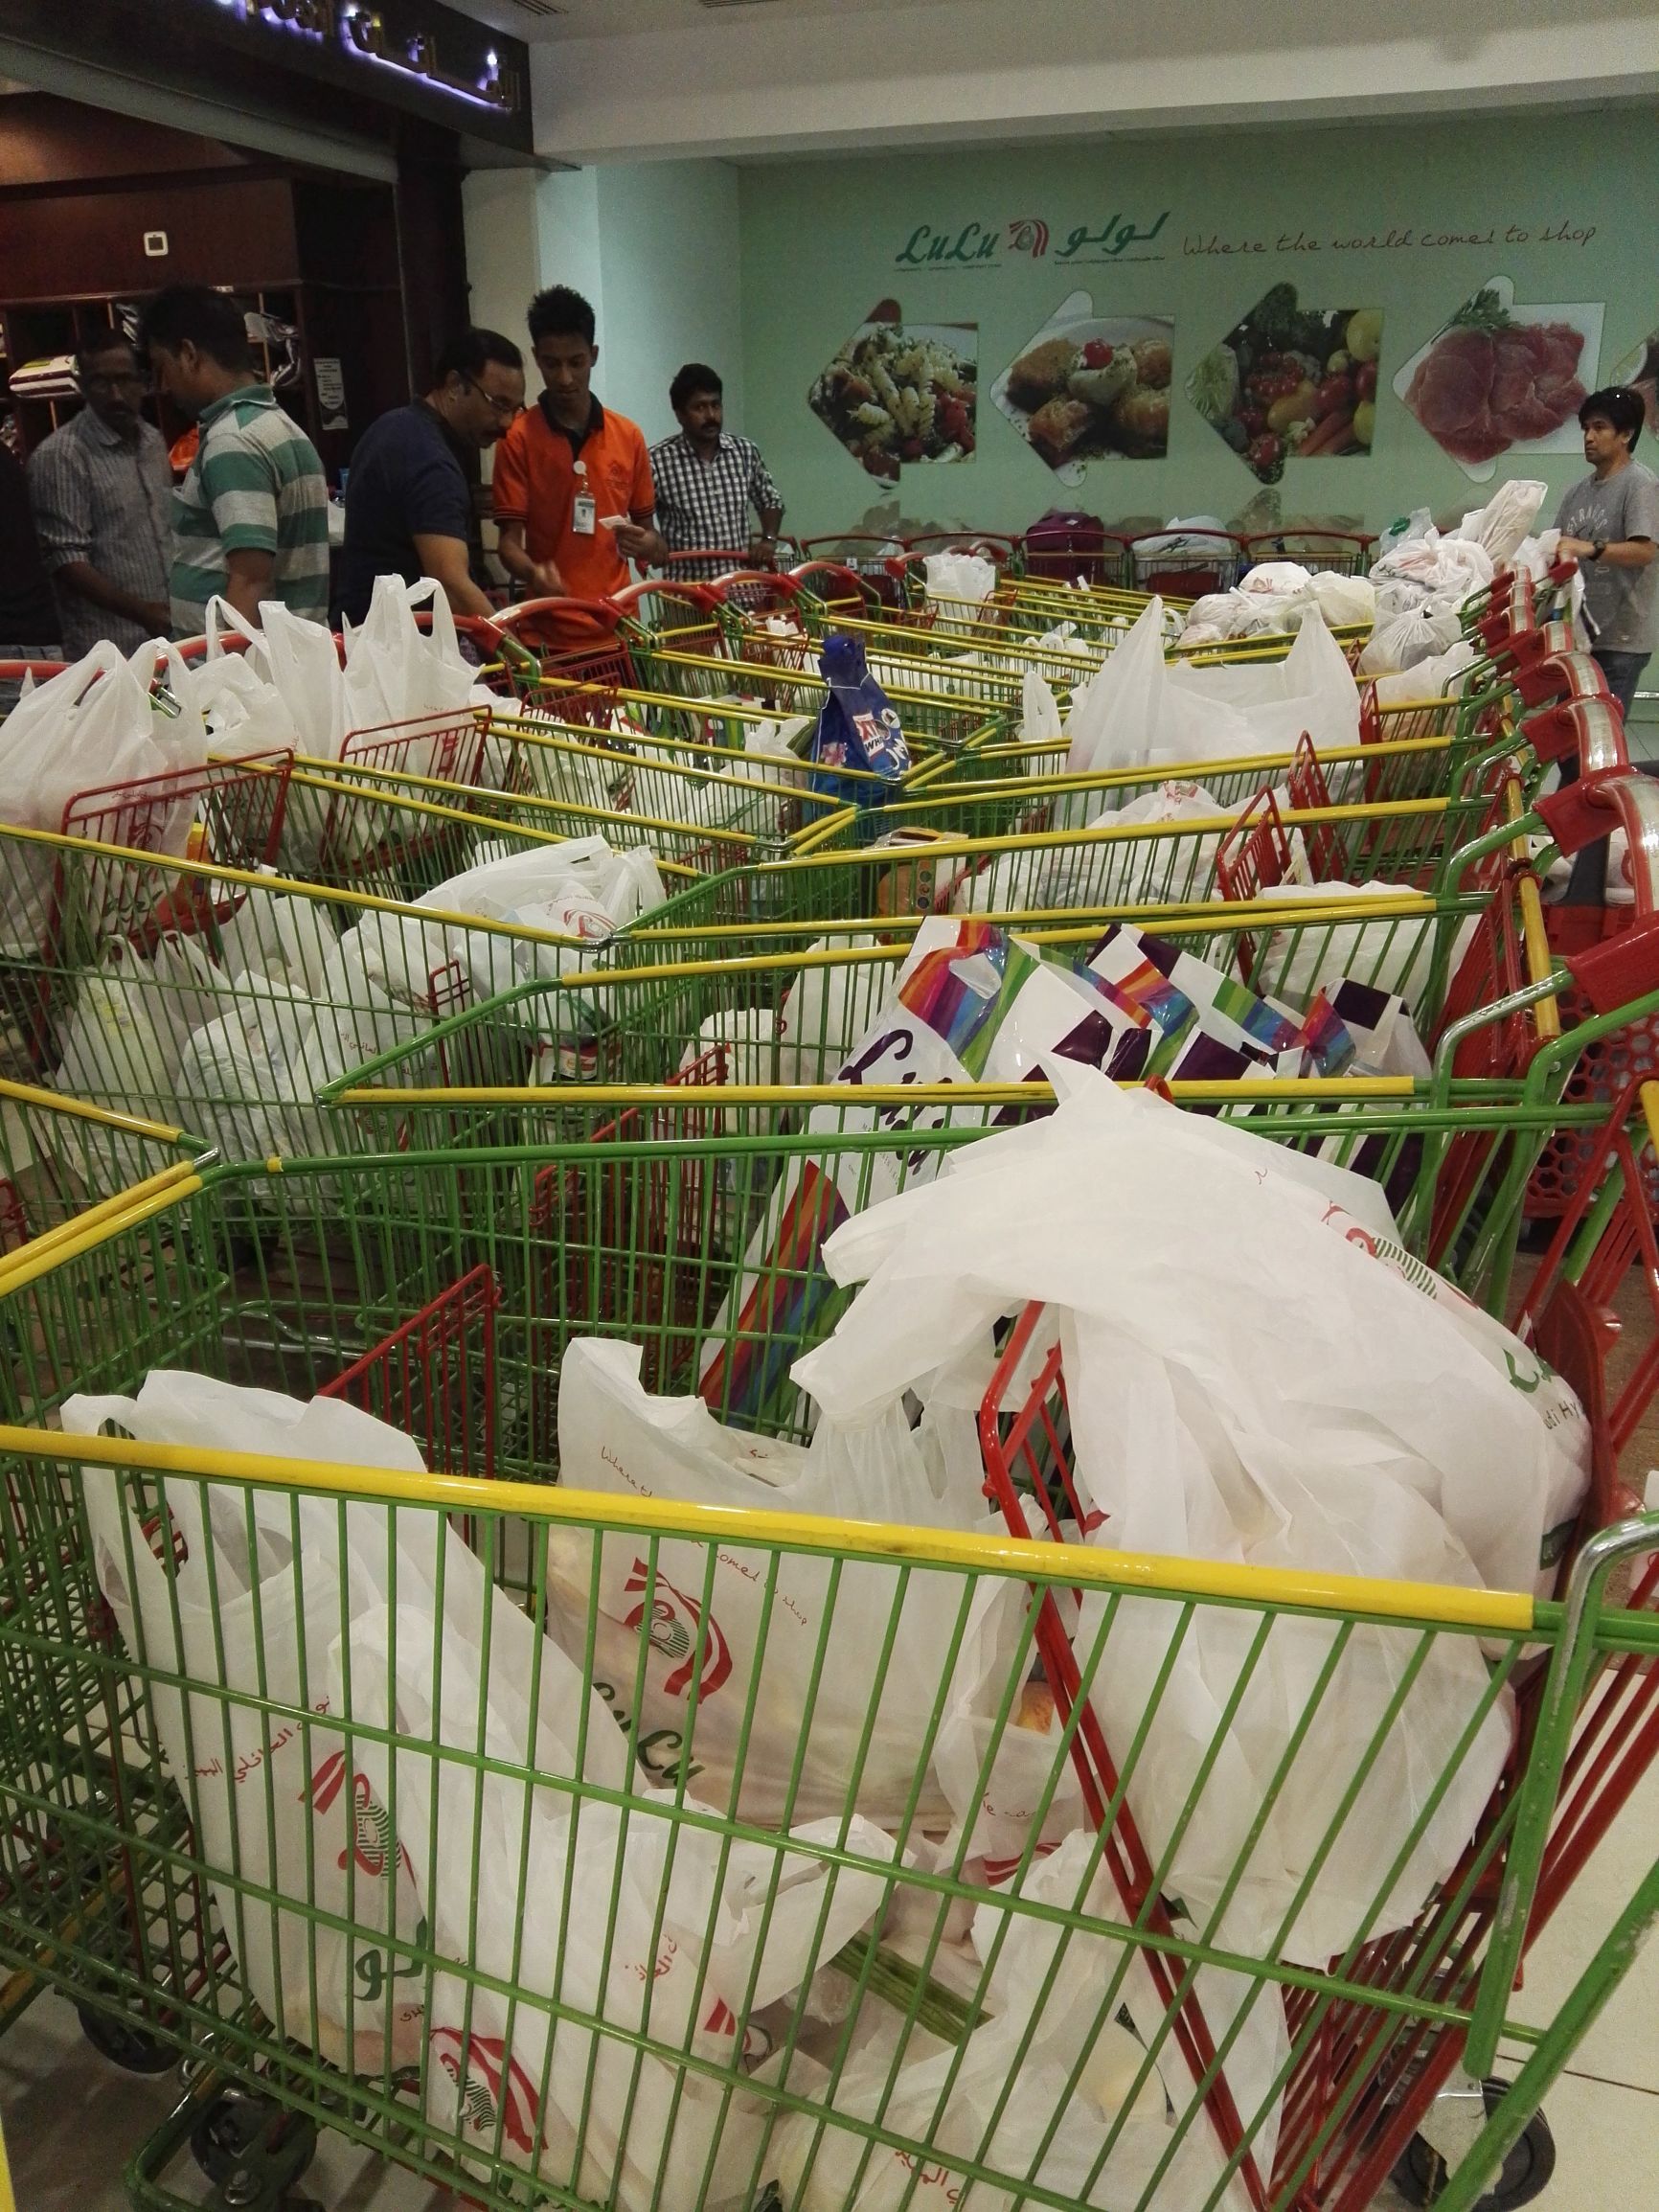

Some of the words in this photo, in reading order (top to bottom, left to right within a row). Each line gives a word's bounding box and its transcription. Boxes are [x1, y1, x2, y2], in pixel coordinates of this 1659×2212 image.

[895, 221, 1000, 263] LuLu
[1055, 211, 1170, 258] لولو
[1182, 234, 1266, 255] Where
[1276, 231, 1322, 252] the
[1332, 229, 1413, 249] world
[1421, 229, 1494, 246] comes
[1505, 224, 1529, 243] to
[1539, 219, 1597, 246] shop
[715, 1552, 761, 1583] omes
